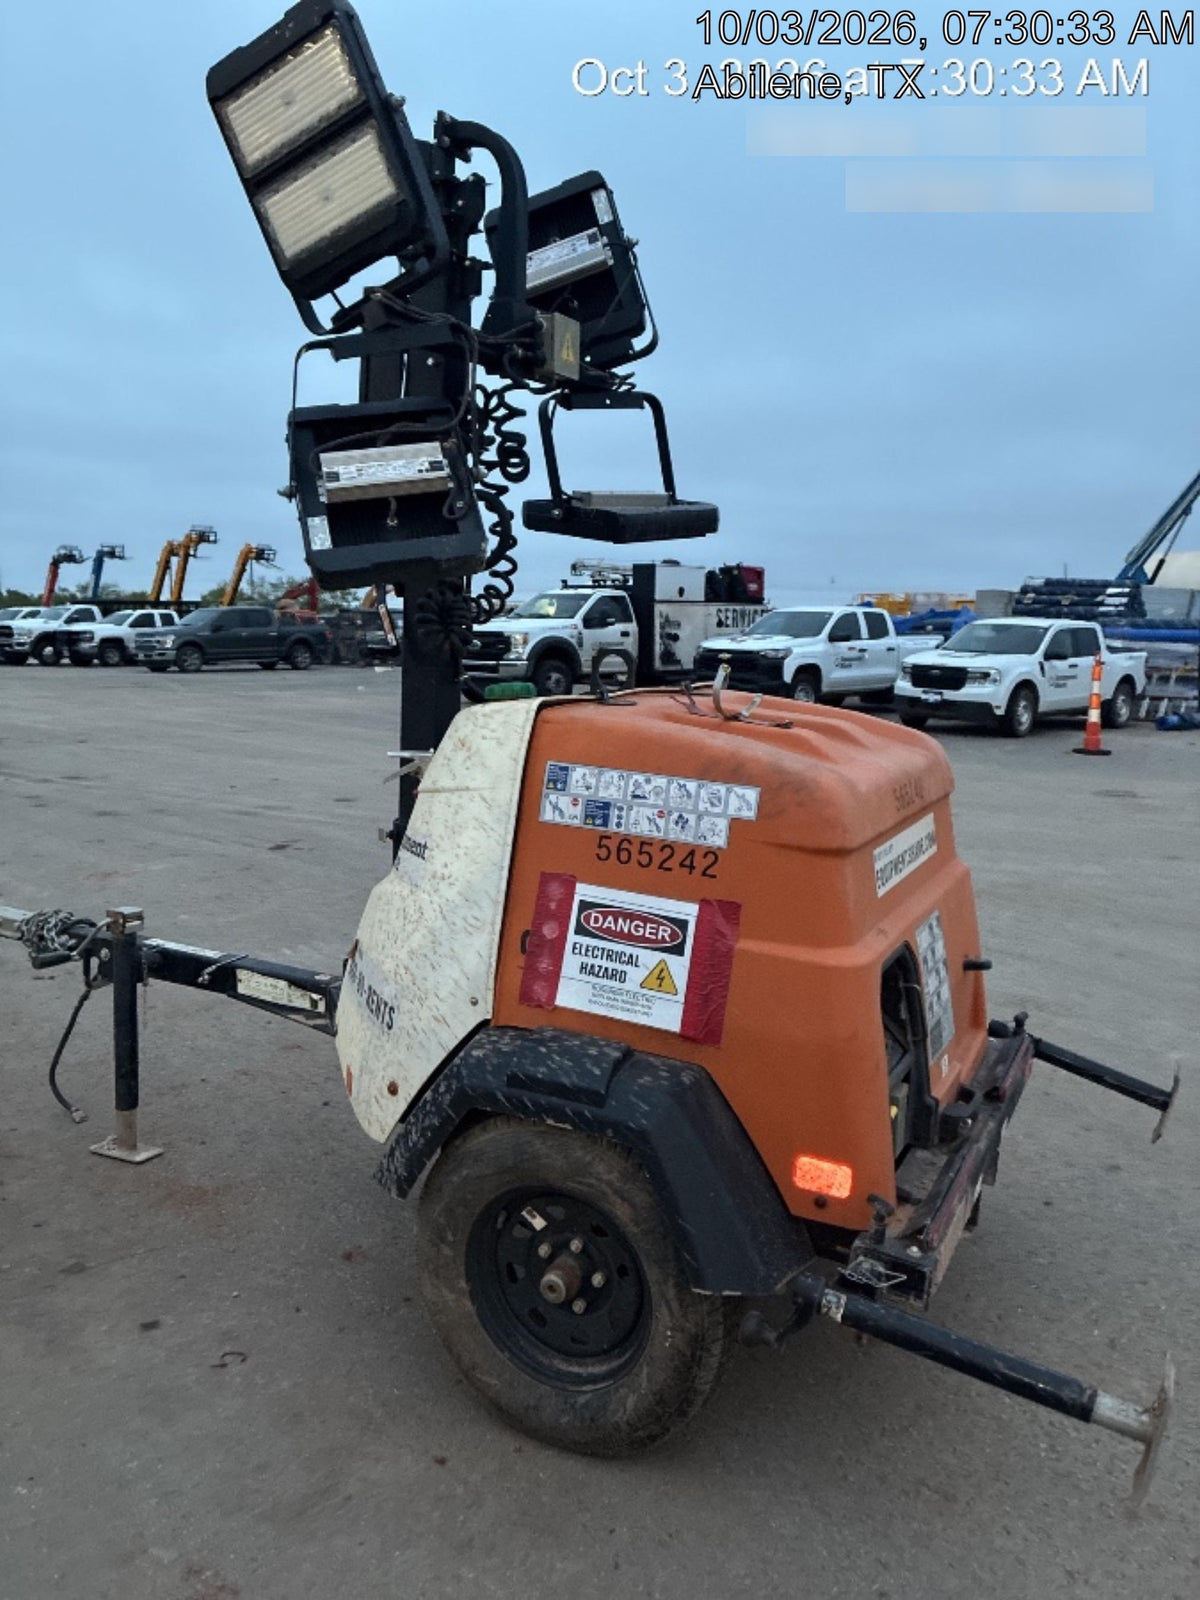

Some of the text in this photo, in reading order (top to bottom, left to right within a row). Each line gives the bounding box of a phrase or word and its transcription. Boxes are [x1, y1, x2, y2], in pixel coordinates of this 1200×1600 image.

[595, 834, 721, 879] 565242
[589, 911, 672, 942] DANGER
[572, 941, 640, 968] ELECTRICAL
[579, 961, 627, 984] HAZARD
